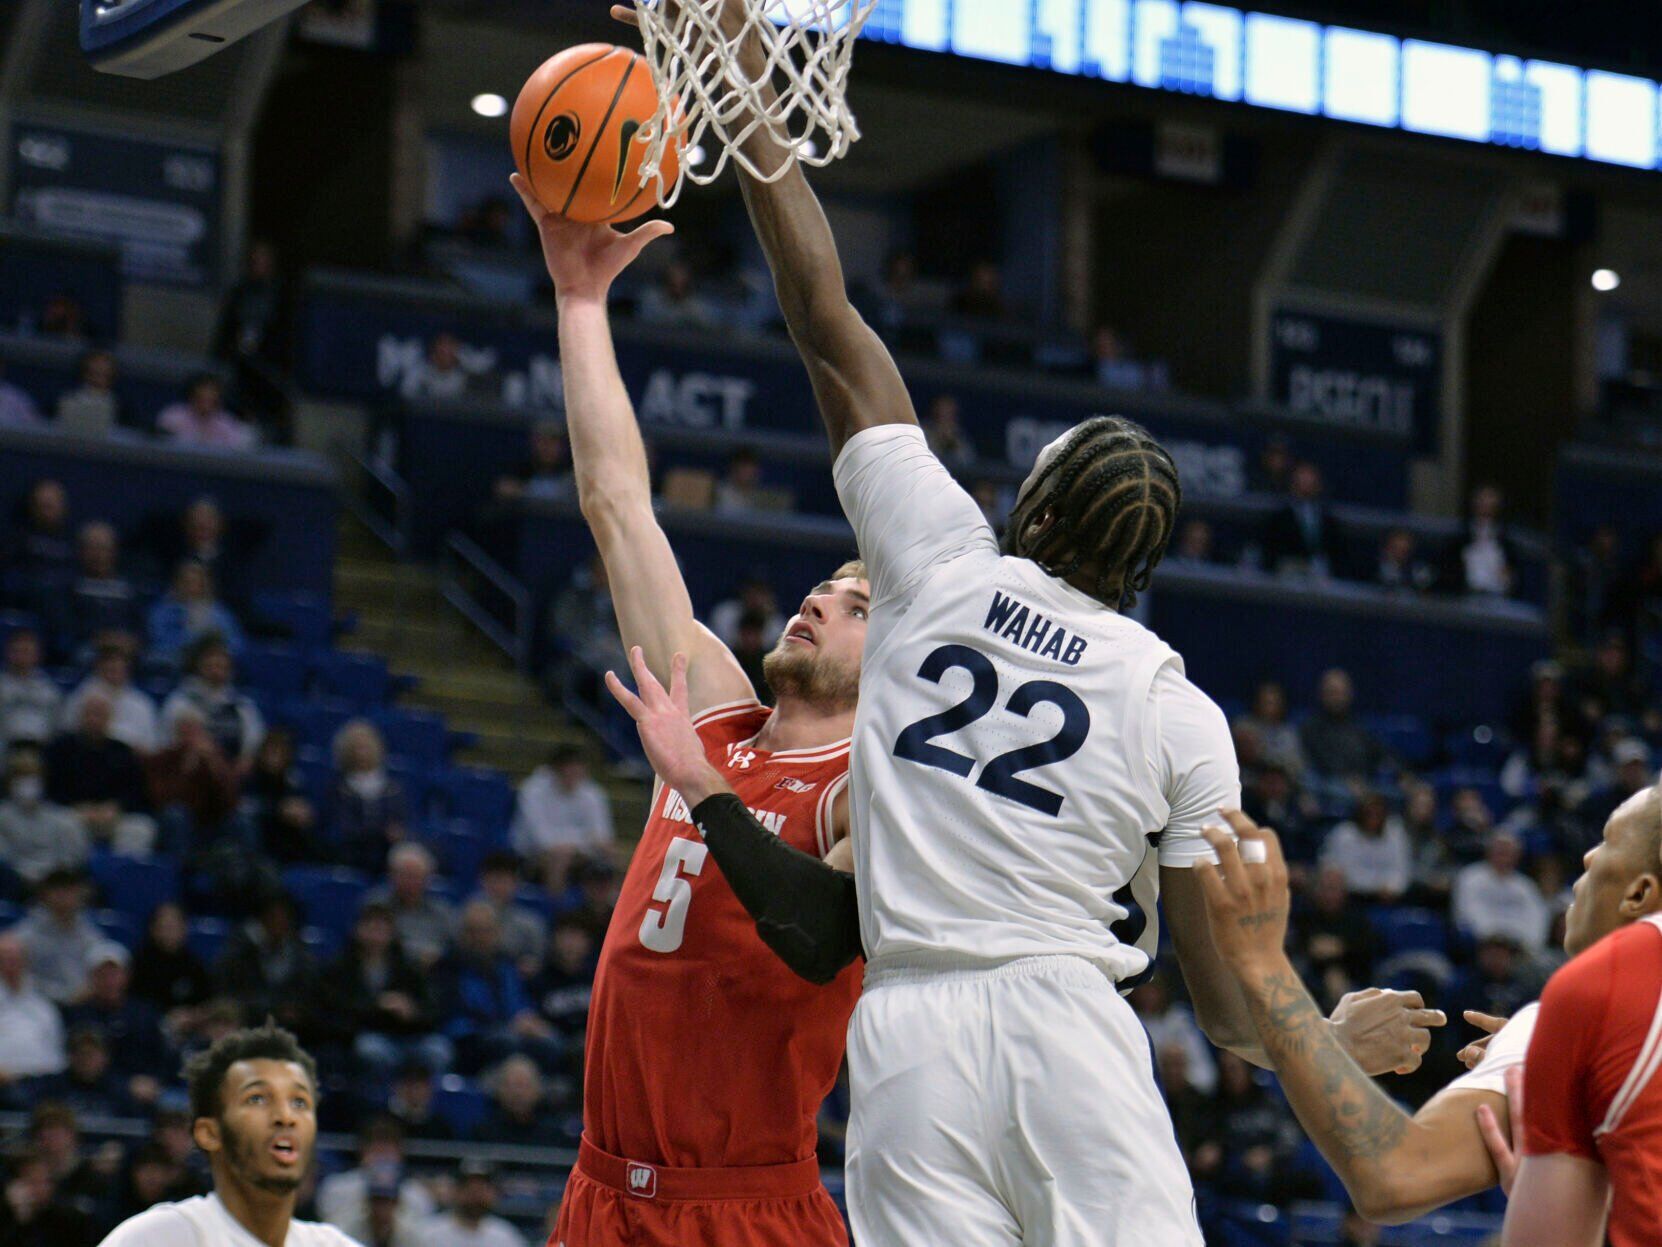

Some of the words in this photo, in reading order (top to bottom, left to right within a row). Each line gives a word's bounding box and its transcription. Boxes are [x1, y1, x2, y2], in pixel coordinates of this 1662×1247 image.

[984, 590, 1088, 666] WAHAB
[893, 644, 1091, 818] 22
[638, 836, 709, 953] 5
